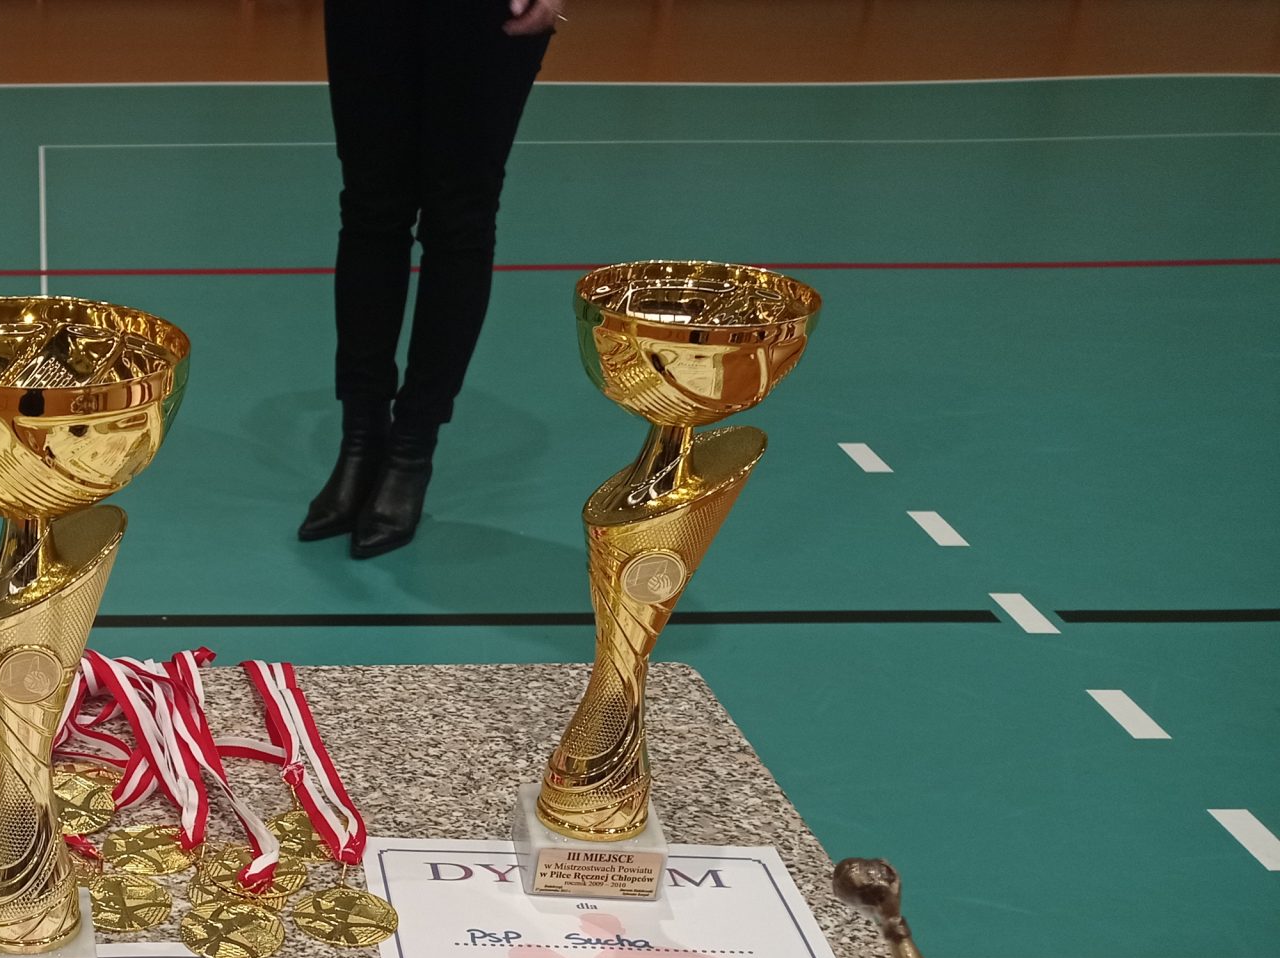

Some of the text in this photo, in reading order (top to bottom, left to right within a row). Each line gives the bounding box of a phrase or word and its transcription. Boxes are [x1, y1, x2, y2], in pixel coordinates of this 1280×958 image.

[567, 852, 634, 863] III MIEJSCE
[554, 863, 615, 872] Mistrzostwach
[467, 929, 654, 949] PSP Sucha
